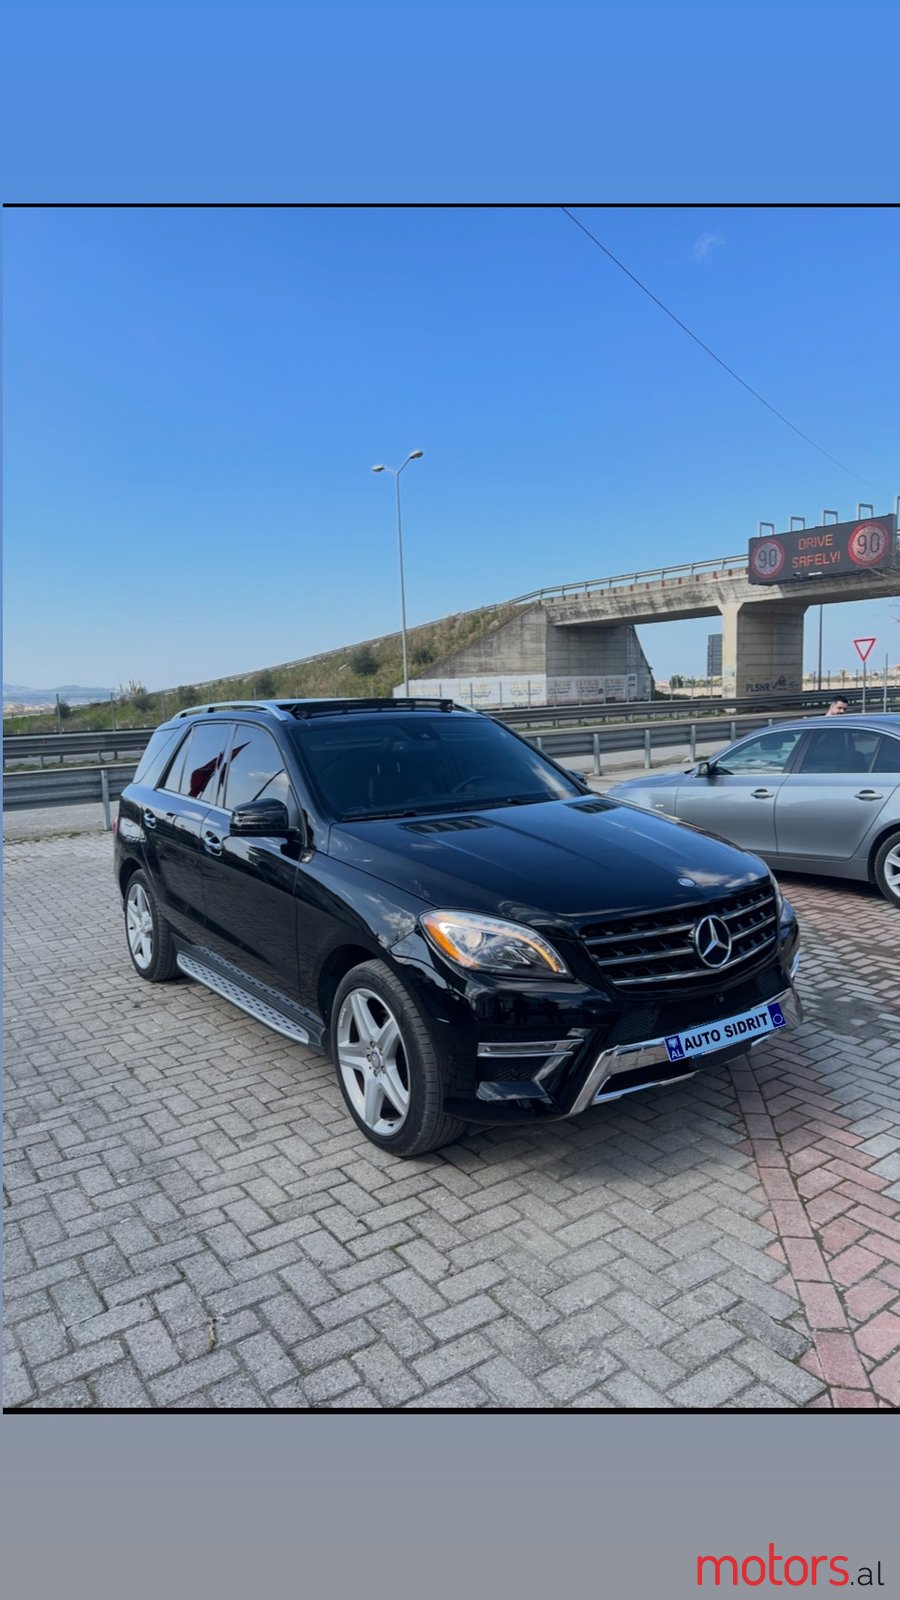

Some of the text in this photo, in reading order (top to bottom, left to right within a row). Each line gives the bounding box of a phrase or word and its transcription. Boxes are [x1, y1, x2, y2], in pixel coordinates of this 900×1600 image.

[798, 534, 834, 550] DRIVE
[857, 532, 880, 555] 90
[758, 548, 778, 569] 90
[792, 551, 841, 569] SAFELY!
[685, 1013, 767, 1051] AUTO SIDRIT
[671, 1049, 684, 1059] AL
